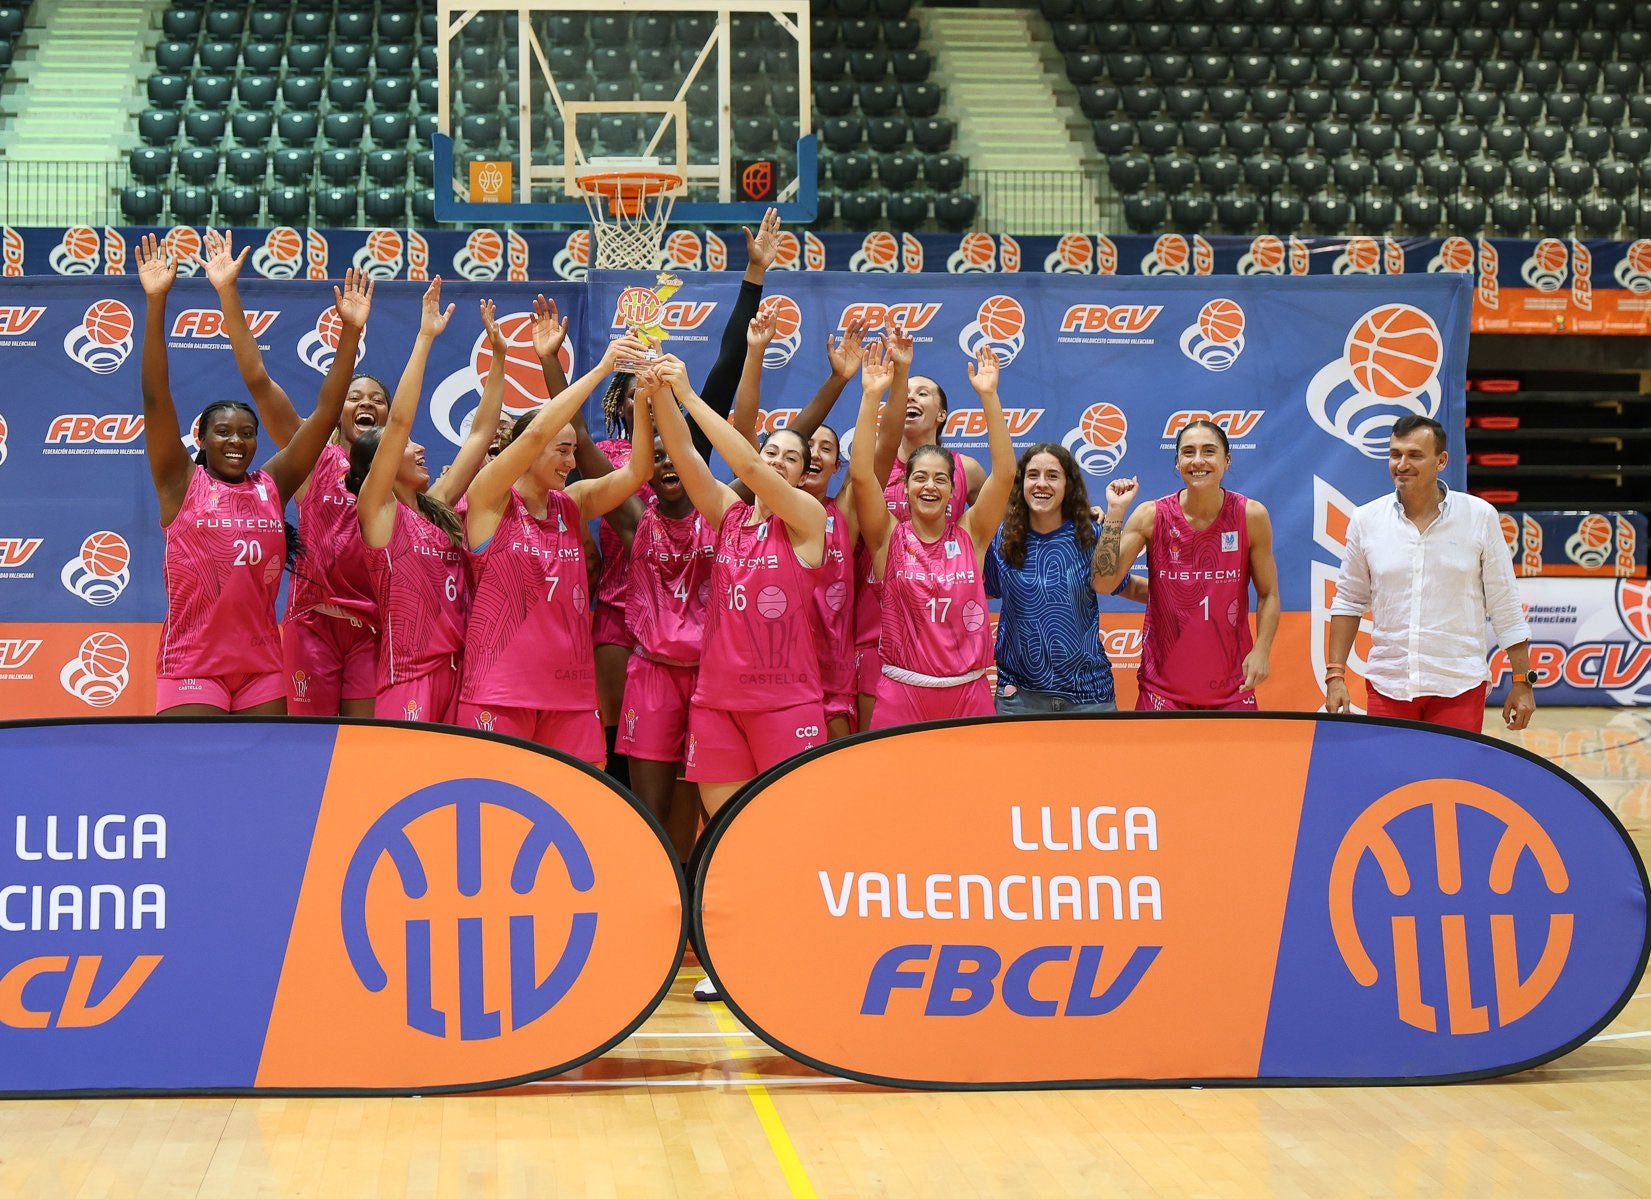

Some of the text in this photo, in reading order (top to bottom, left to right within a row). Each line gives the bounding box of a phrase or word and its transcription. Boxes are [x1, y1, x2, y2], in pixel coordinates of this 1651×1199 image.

[3, 225, 24, 276] BCV
[104, 225, 126, 275] BCV
[307, 227, 328, 280] BCV
[408, 228, 428, 281] BCV
[508, 229, 529, 281] BCV
[1478, 237, 1499, 310] FBCV
[1572, 237, 1592, 311] FBCV
[170, 309, 280, 338] FBV
[837, 303, 943, 331] FBCV
[1060, 304, 1164, 333] FBCV
[45, 414, 144, 443] FBCV
[941, 408, 1045, 437] FBV
[233, 540, 262, 566] 20
[445, 575, 457, 601] 6
[545, 576, 559, 601] 7
[674, 579, 688, 602] 4
[728, 584, 747, 611] 16
[926, 598, 952, 623] 17
[1199, 596, 1209, 620] 1
[739, 673, 808, 685] CASTELLO
[1488, 642, 1651, 690] FBCV
[15, 813, 167, 862] LLIGA
[1010, 804, 1158, 852] LLIGA
[0, 884, 166, 931] CIANA
[817, 869, 1162, 922] VALENCIANA
[0, 954, 165, 1030] CV
[859, 943, 1164, 1018] FBCV
